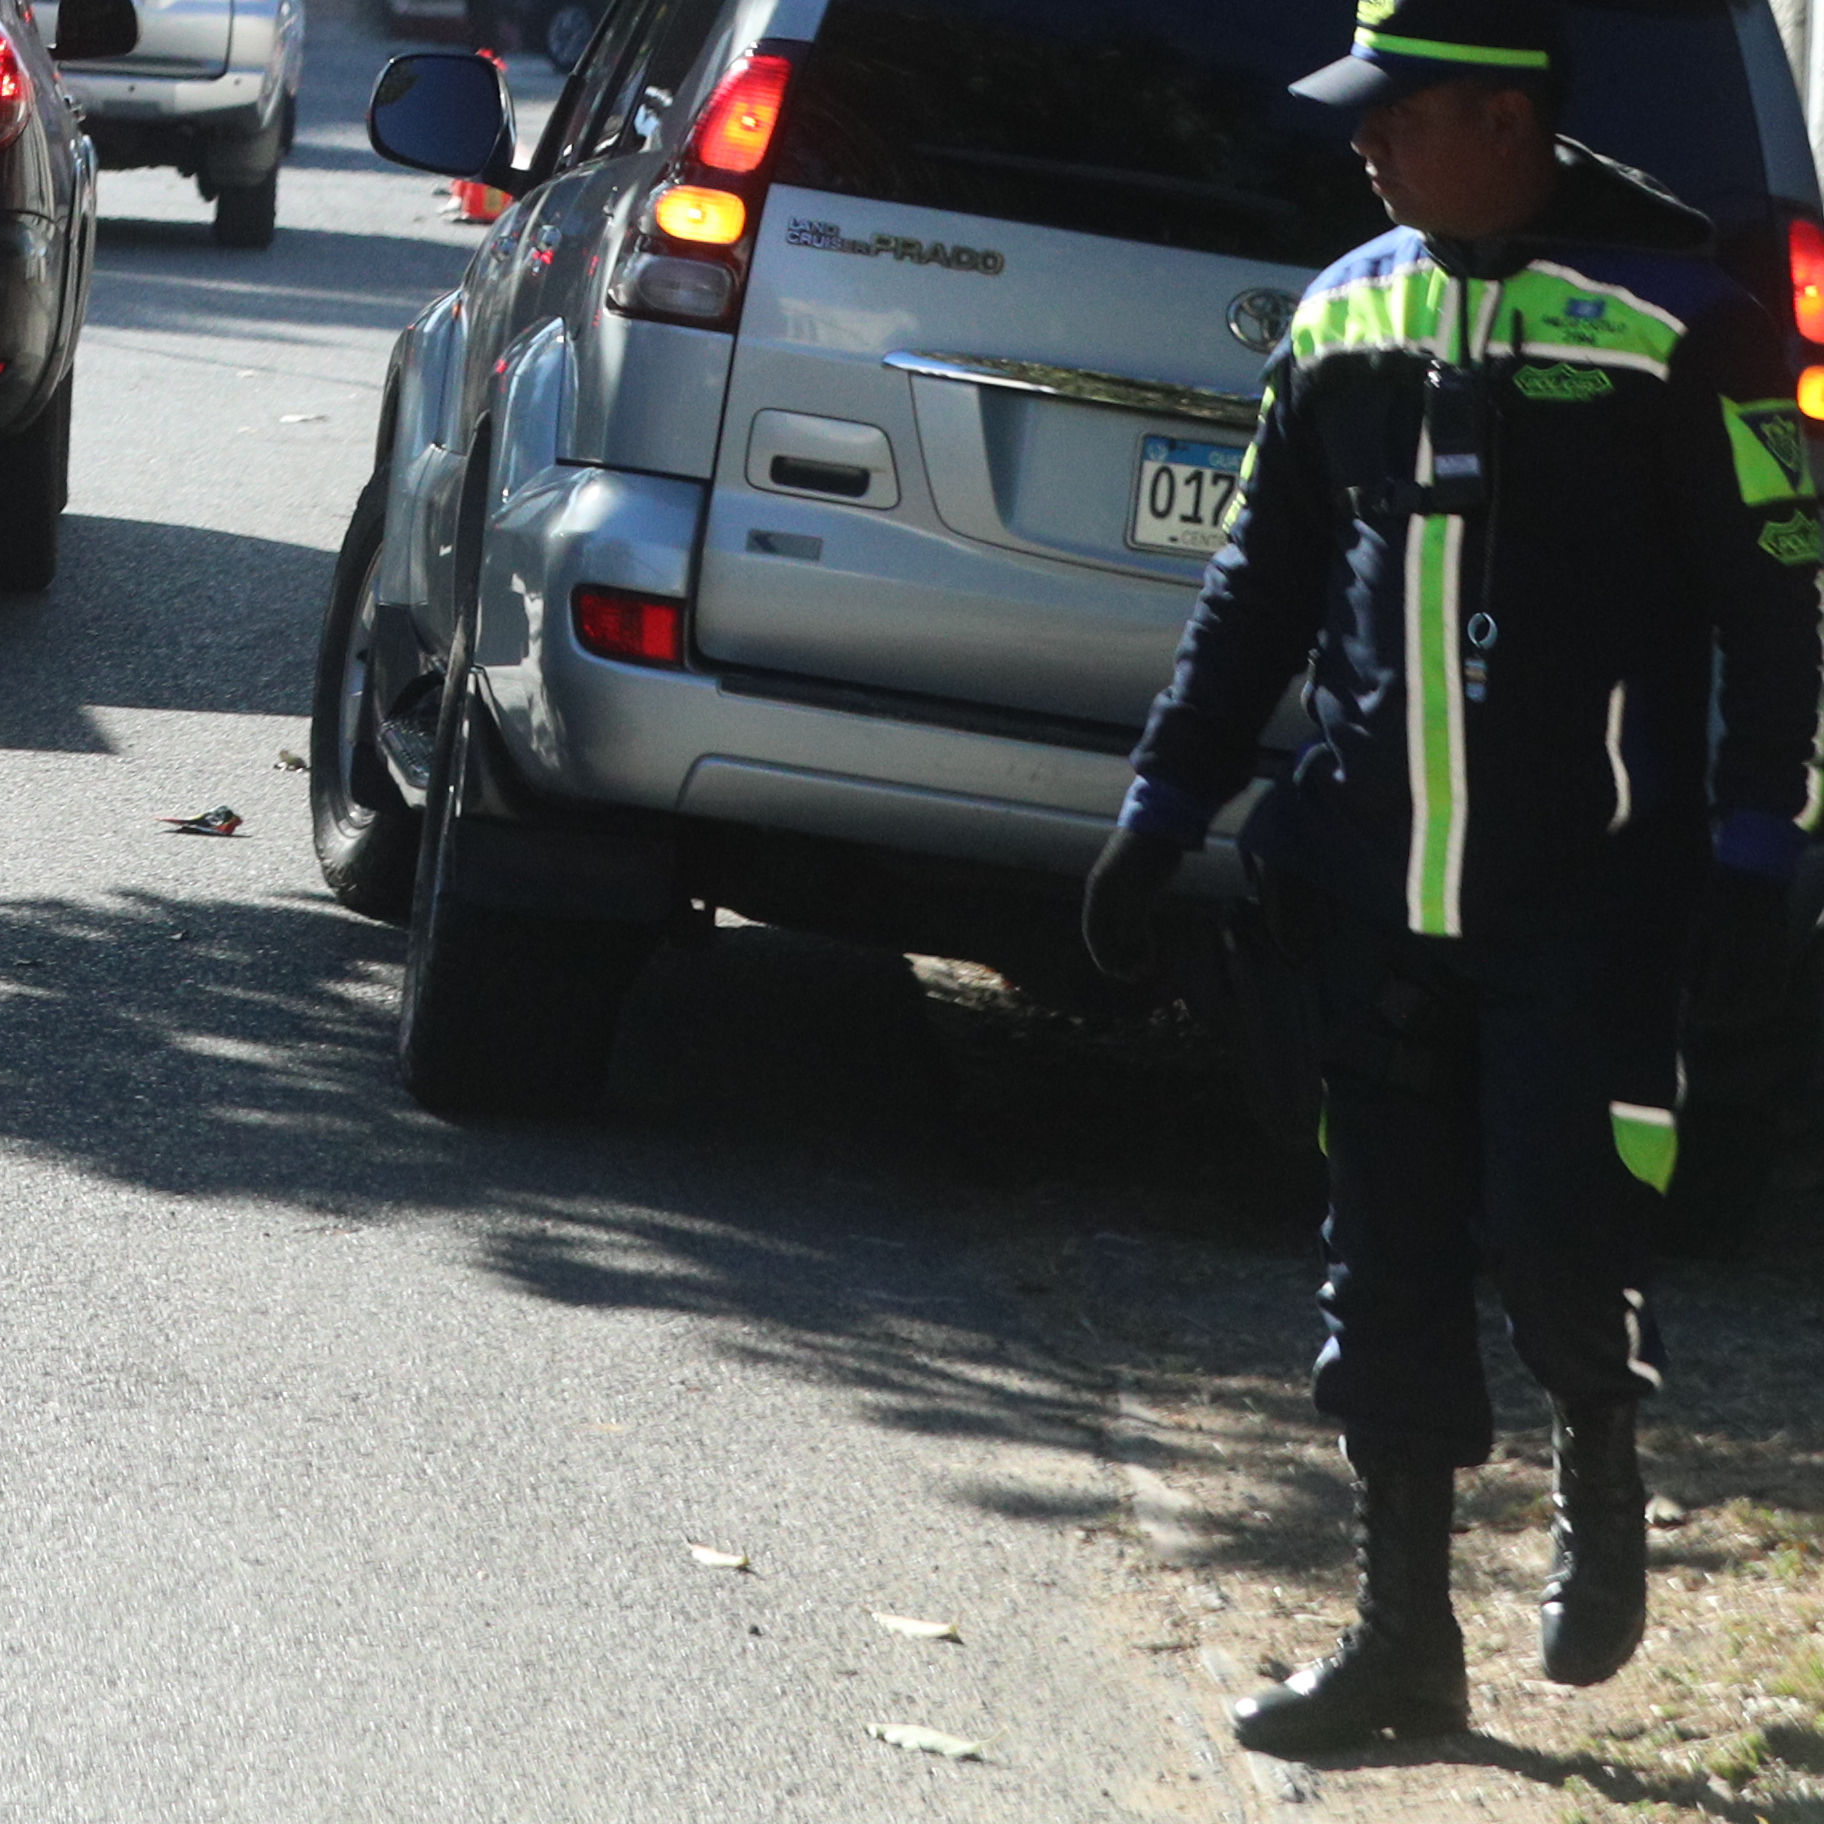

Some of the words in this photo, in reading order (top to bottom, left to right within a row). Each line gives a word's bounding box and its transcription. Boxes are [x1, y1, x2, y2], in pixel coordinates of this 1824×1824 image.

[788, 216, 840, 237] LAND
[785, 230, 873, 257] CRUISER
[871, 232, 1005, 276] PRADO
